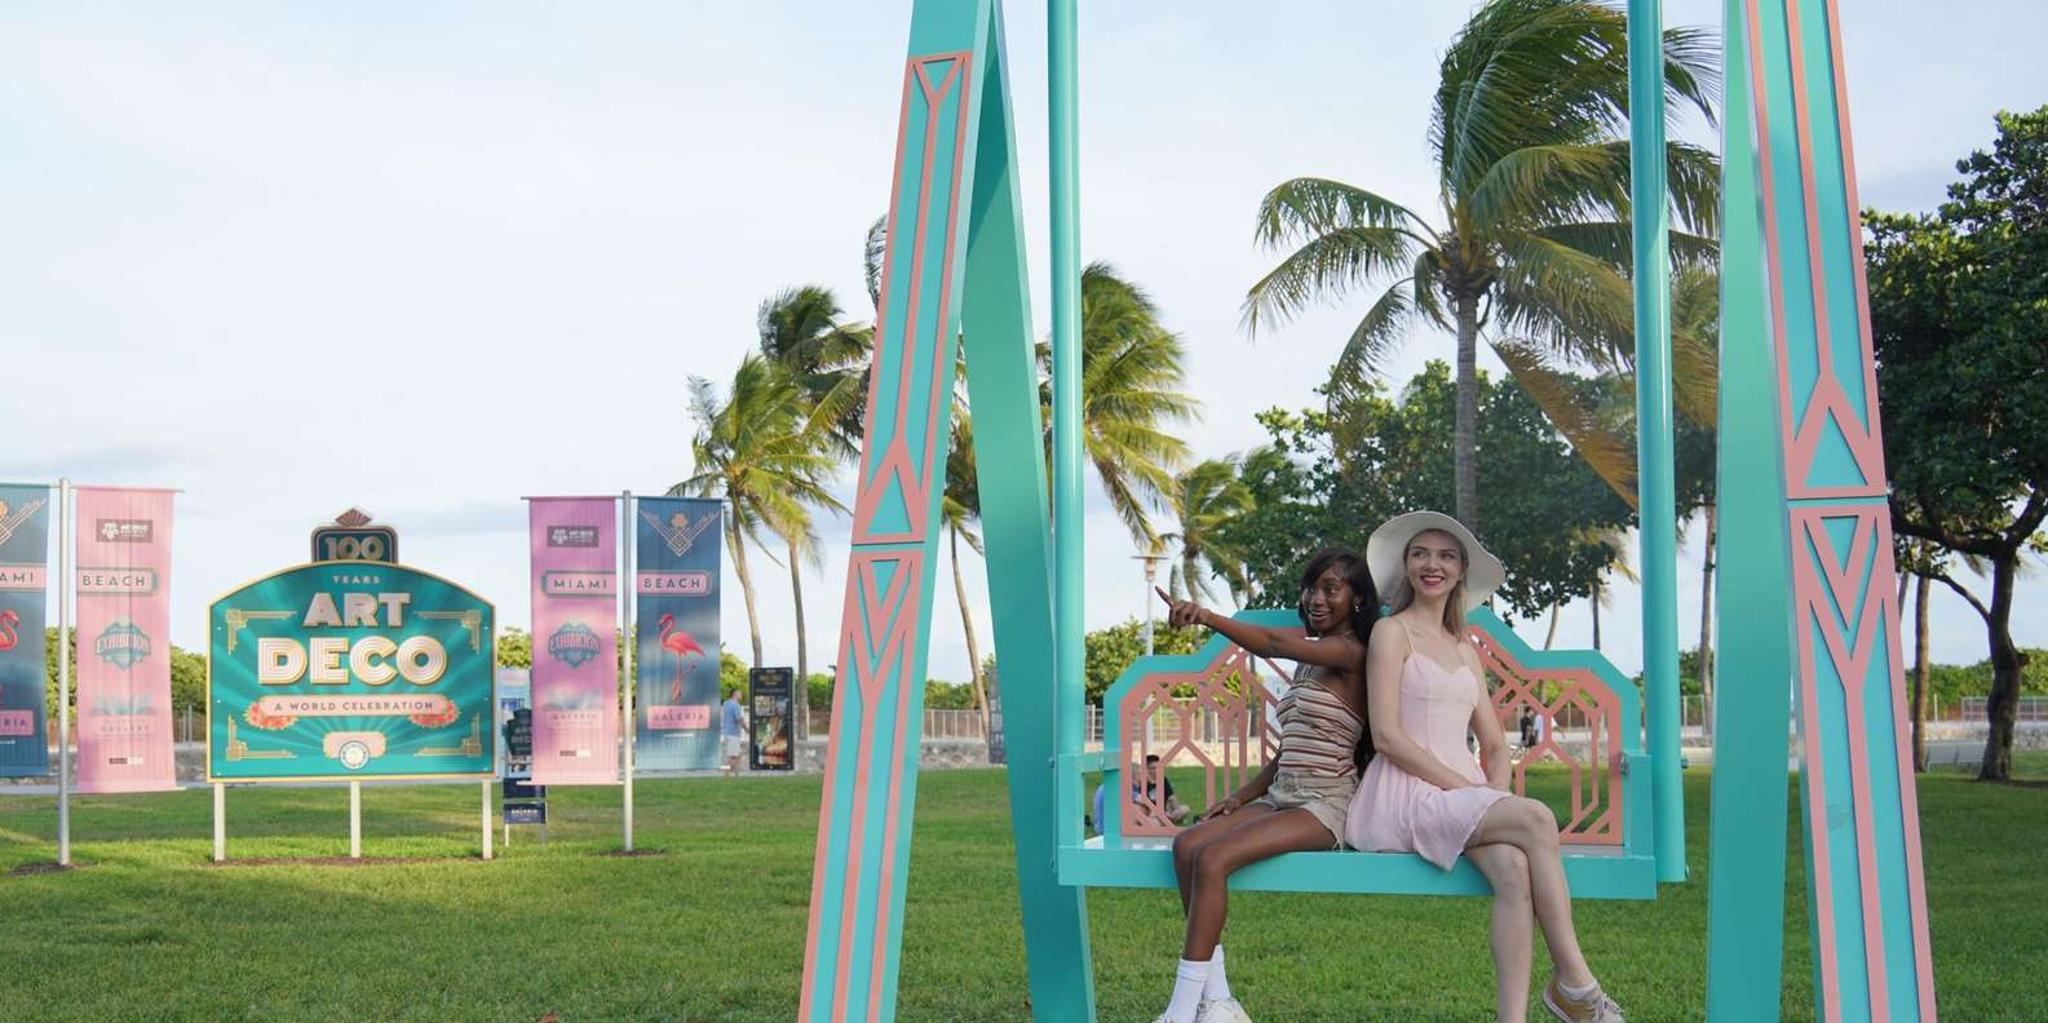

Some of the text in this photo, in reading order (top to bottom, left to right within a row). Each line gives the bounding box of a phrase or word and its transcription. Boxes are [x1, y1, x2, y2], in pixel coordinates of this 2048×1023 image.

[324, 536, 384, 561] 100
[82, 575, 146, 586] BEACH
[332, 575, 381, 585] YEARS
[553, 579, 607, 589] MIAMI
[643, 578, 701, 589] BEACH
[302, 591, 411, 629] ART
[257, 634, 448, 686] DECO
[274, 701, 434, 712] A WORLD CELEBRATION
